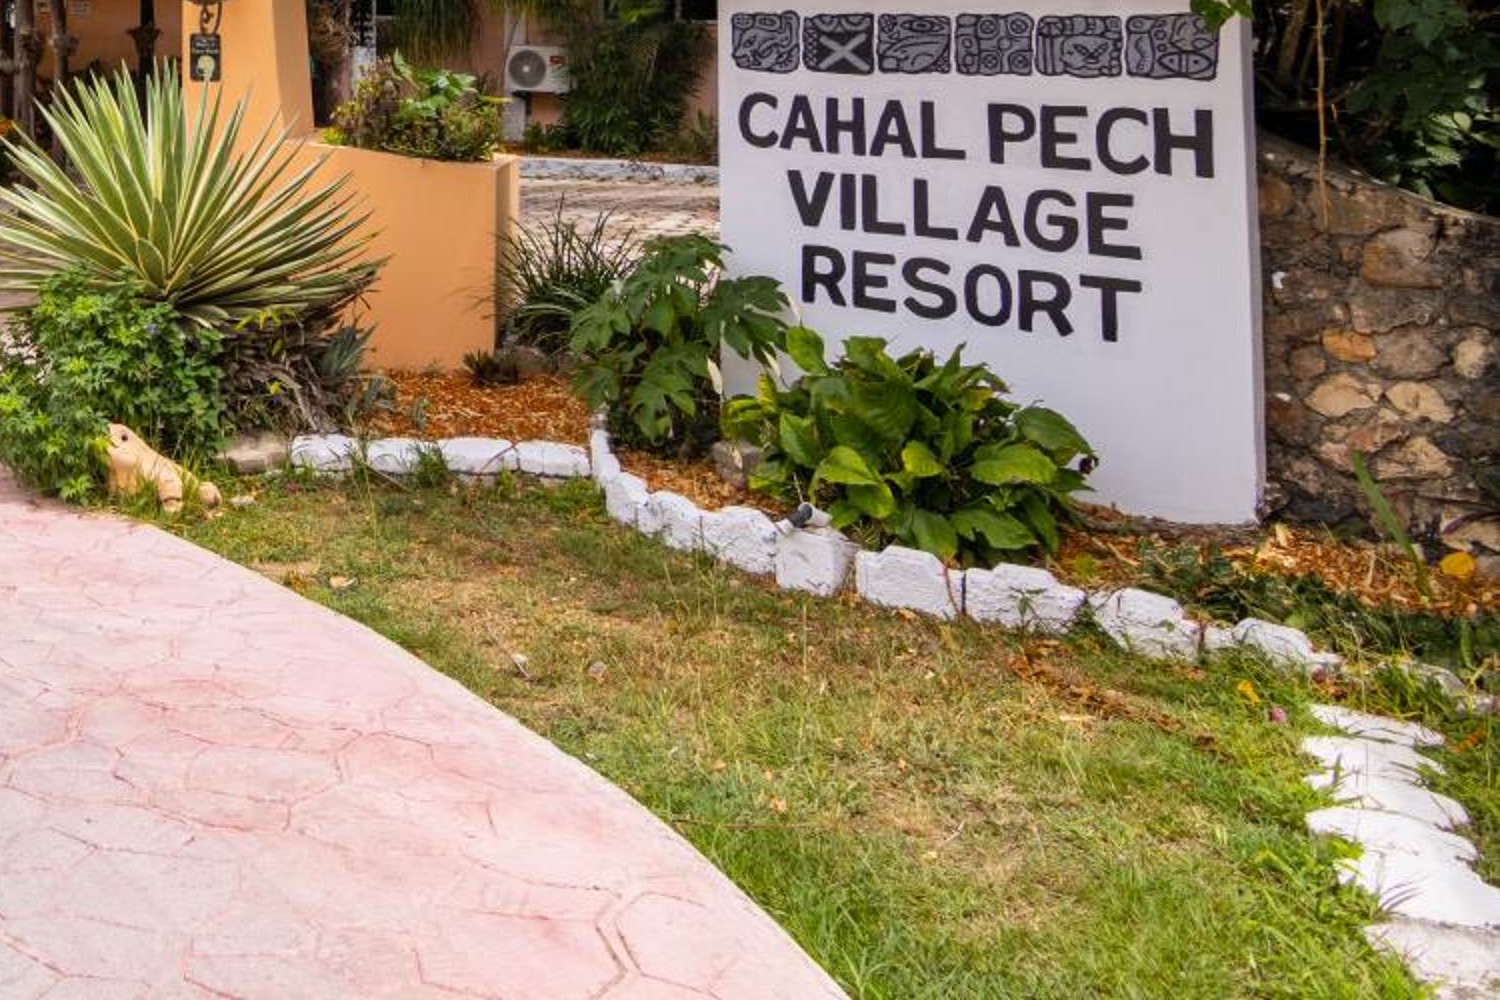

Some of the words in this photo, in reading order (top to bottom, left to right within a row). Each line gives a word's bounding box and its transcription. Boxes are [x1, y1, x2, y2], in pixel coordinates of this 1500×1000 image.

[738, 92, 967, 160] CAHAL
[987, 103, 1215, 179] PECH
[787, 169, 1143, 260] VILLAGE
[801, 244, 1142, 343] RESORT
